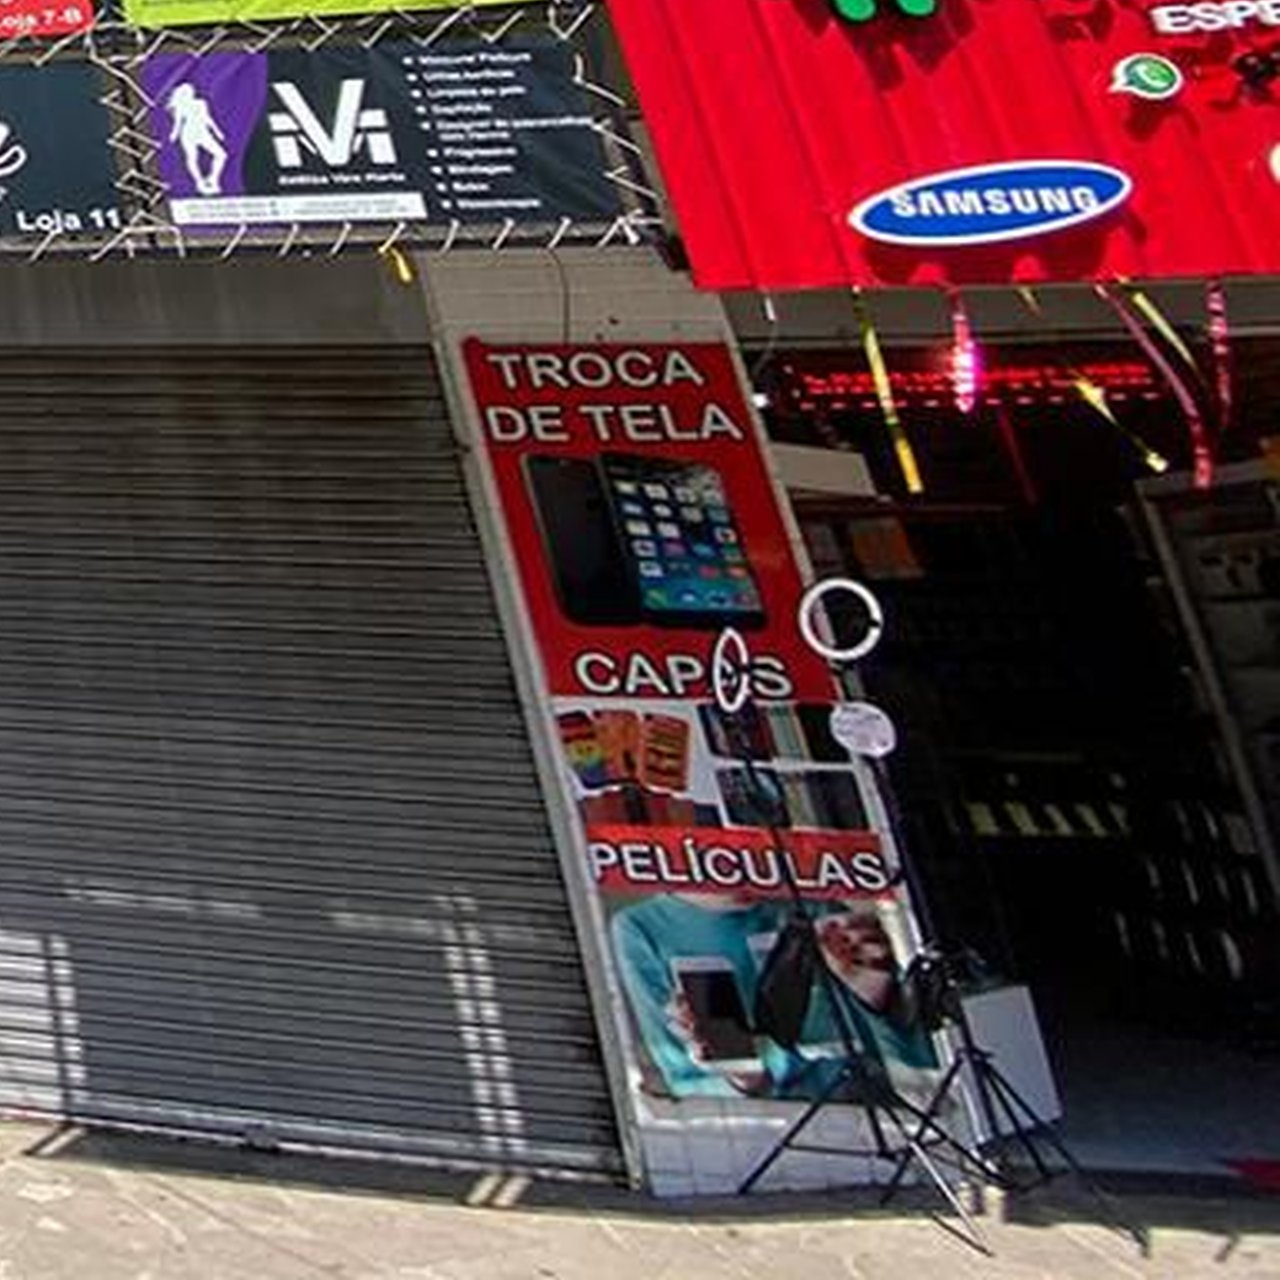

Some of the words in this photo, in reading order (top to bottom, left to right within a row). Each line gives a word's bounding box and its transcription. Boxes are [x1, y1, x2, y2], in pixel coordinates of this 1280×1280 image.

[17, 210, 82, 234] Loja
[89, 209, 122, 230] 11
[890, 185, 1100, 218] SAMSUNG
[486, 350, 705, 390] TROCA
[485, 405, 570, 443] DE
[579, 402, 744, 441] TELA
[588, 838, 894, 891] PELÍCULAS
